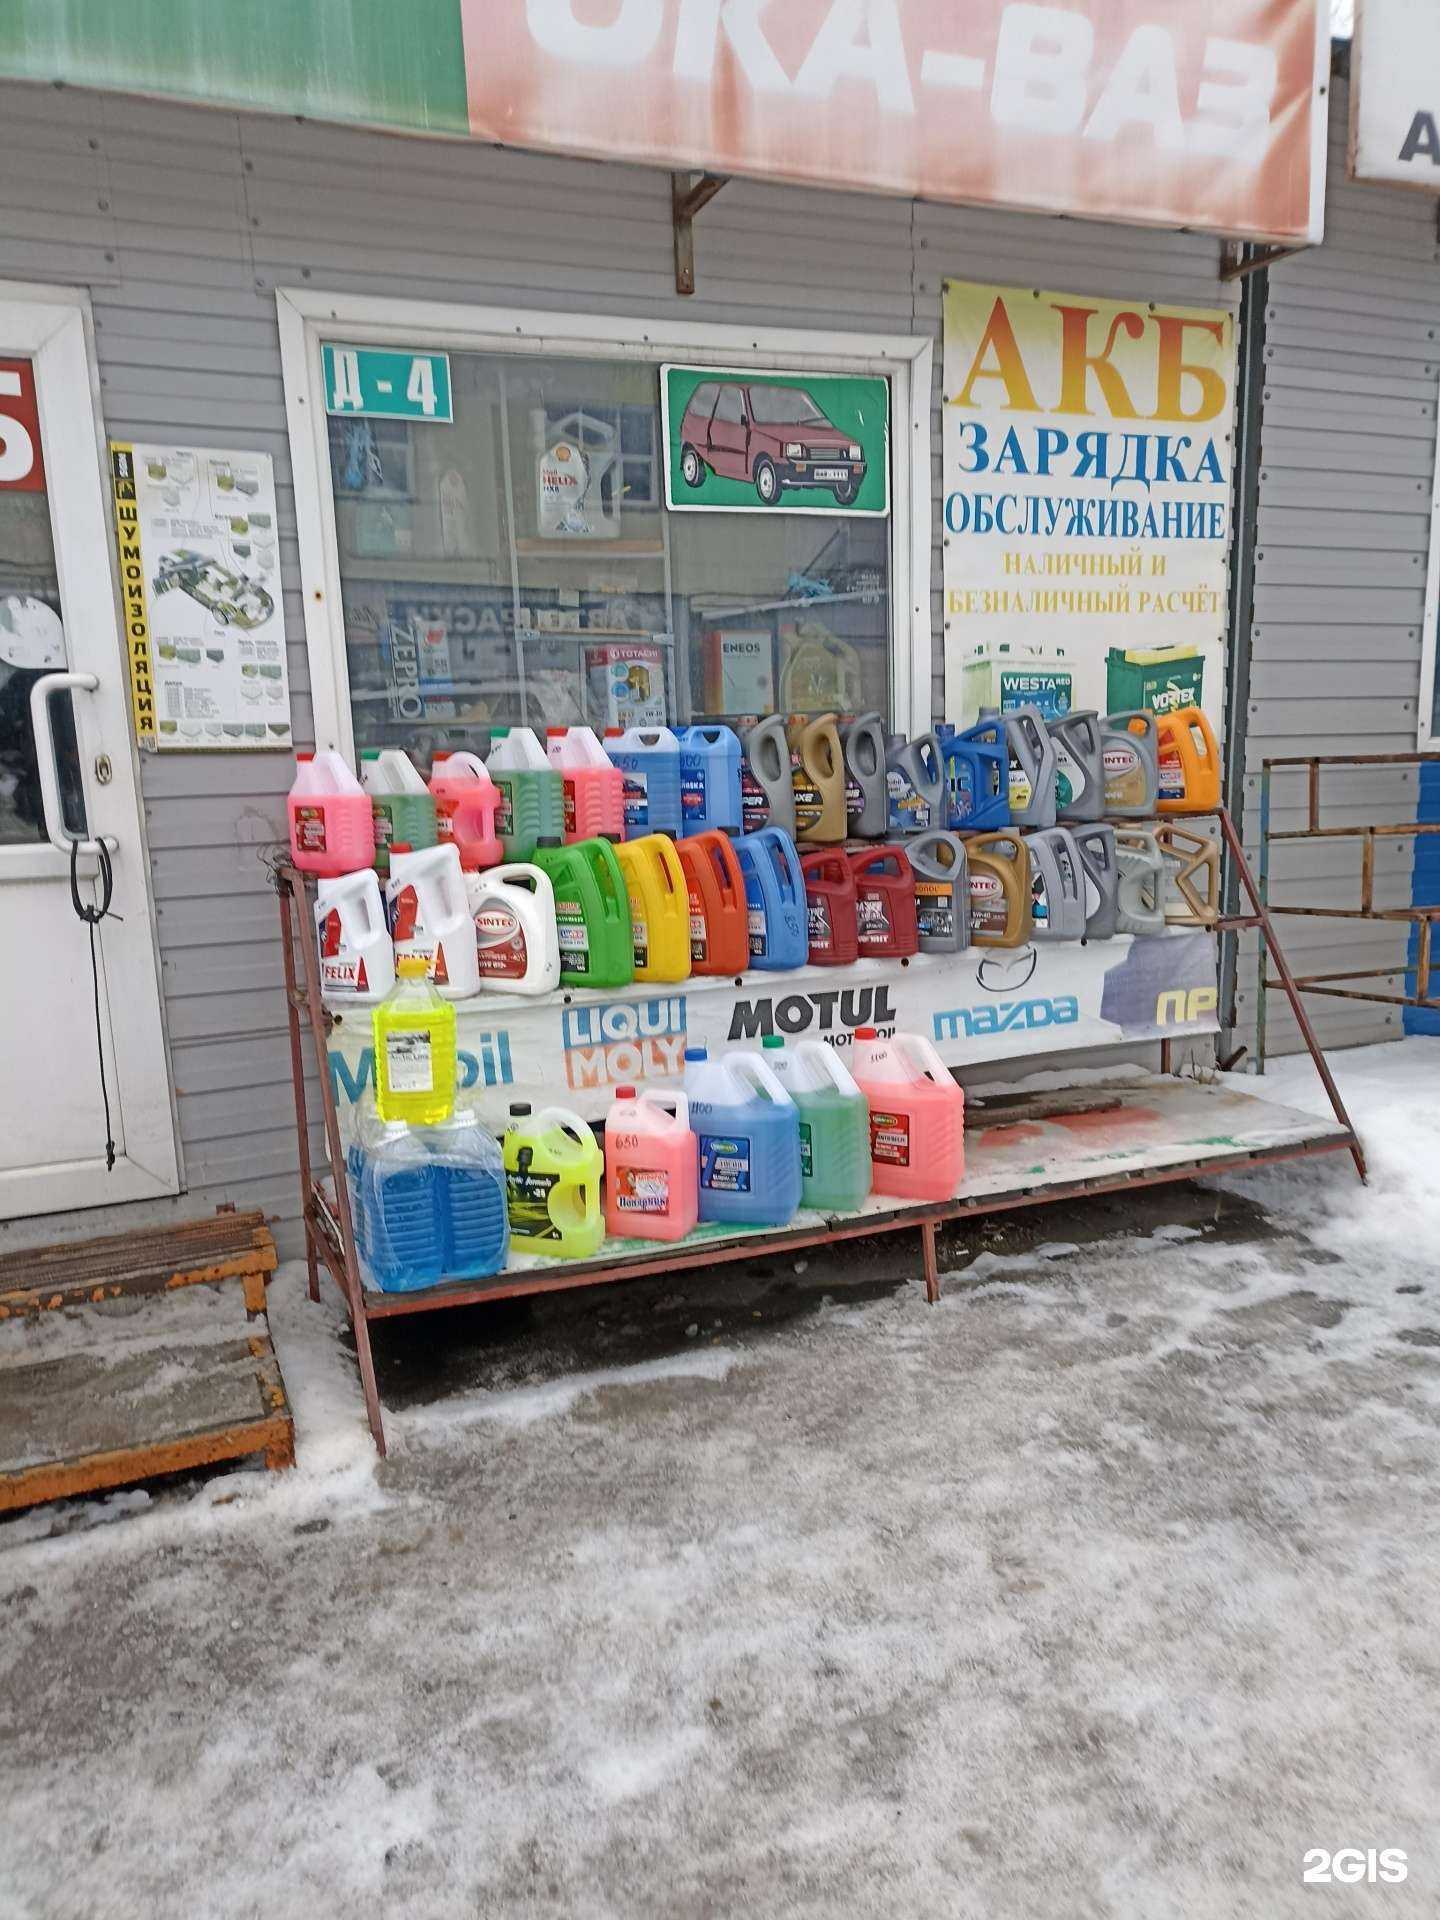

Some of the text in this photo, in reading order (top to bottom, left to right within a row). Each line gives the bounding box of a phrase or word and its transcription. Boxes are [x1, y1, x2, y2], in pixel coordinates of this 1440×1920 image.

[949, 295, 1227, 423] АКБ
[958, 422, 1226, 491] ЗАРЯДКА
[945, 492, 1225, 540] ОБСЛУЖИВАНИЕ
[1003, 548, 1167, 578] НАЛИЧНЫЙ И
[119, 505, 154, 730] ШУМОИЗОЛЯЦИЯ
[949, 584, 1222, 615] БЕЗНАЛИЧНЫЙ РАСЧЁТ
[391, 624, 422, 719] ZEPRO
[723, 642, 761, 654] ENEOS
[1003, 677, 1056, 690] WESTA
[1104, 756, 1135, 765] INTEC
[477, 917, 514, 927] SINTEC
[325, 965, 355, 980] FELIX
[570, 998, 684, 1046] LIQUI
[727, 985, 897, 1041] MOTUL
[571, 1038, 684, 1090] MOLY
